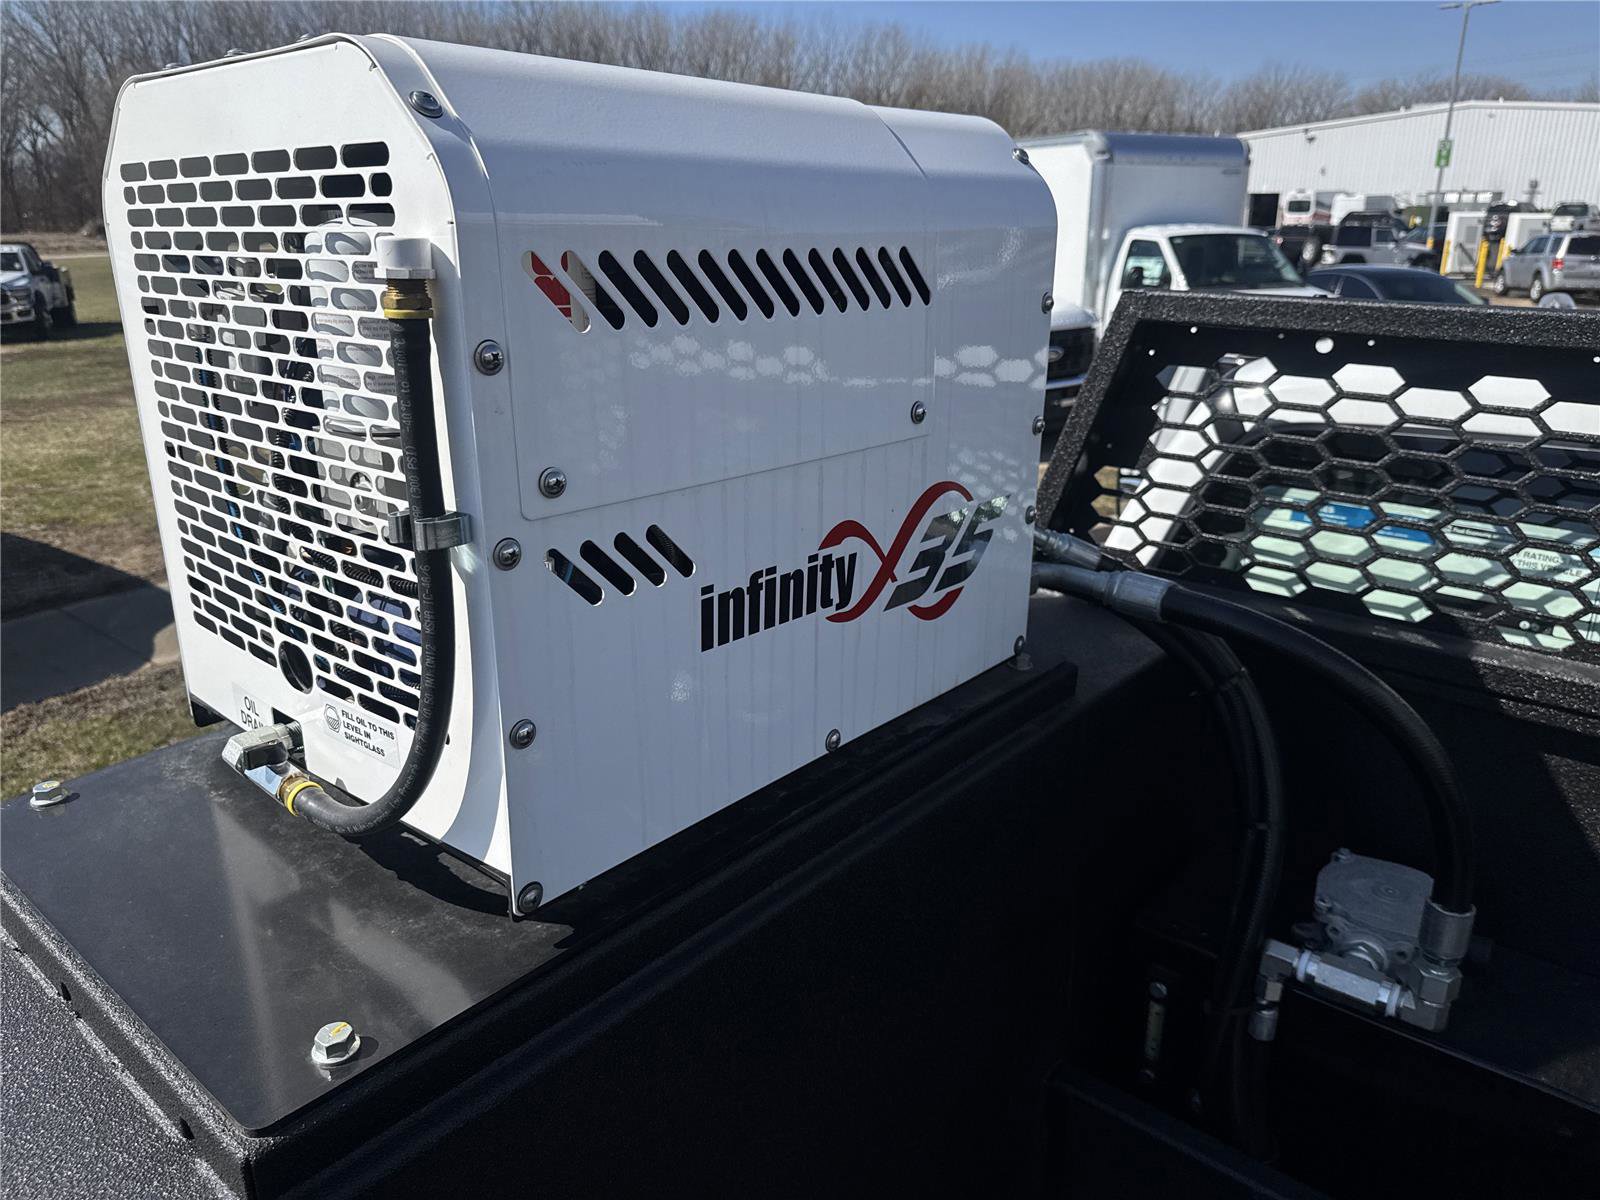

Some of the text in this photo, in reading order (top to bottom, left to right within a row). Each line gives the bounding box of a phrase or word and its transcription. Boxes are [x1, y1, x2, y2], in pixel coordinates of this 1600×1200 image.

[399, 380, 409, 393] to
[404, 445, 417, 470] PSI)
[701, 494, 1011, 652] infinity 35
[1518, 559, 1538, 570] THIS
[244, 696, 259, 717] OIL
[342, 710, 394, 740] FILL OIL TO THIS
[343, 721, 371, 739] LEVEL IN
[344, 732, 385, 756] SIGHTGLASS
